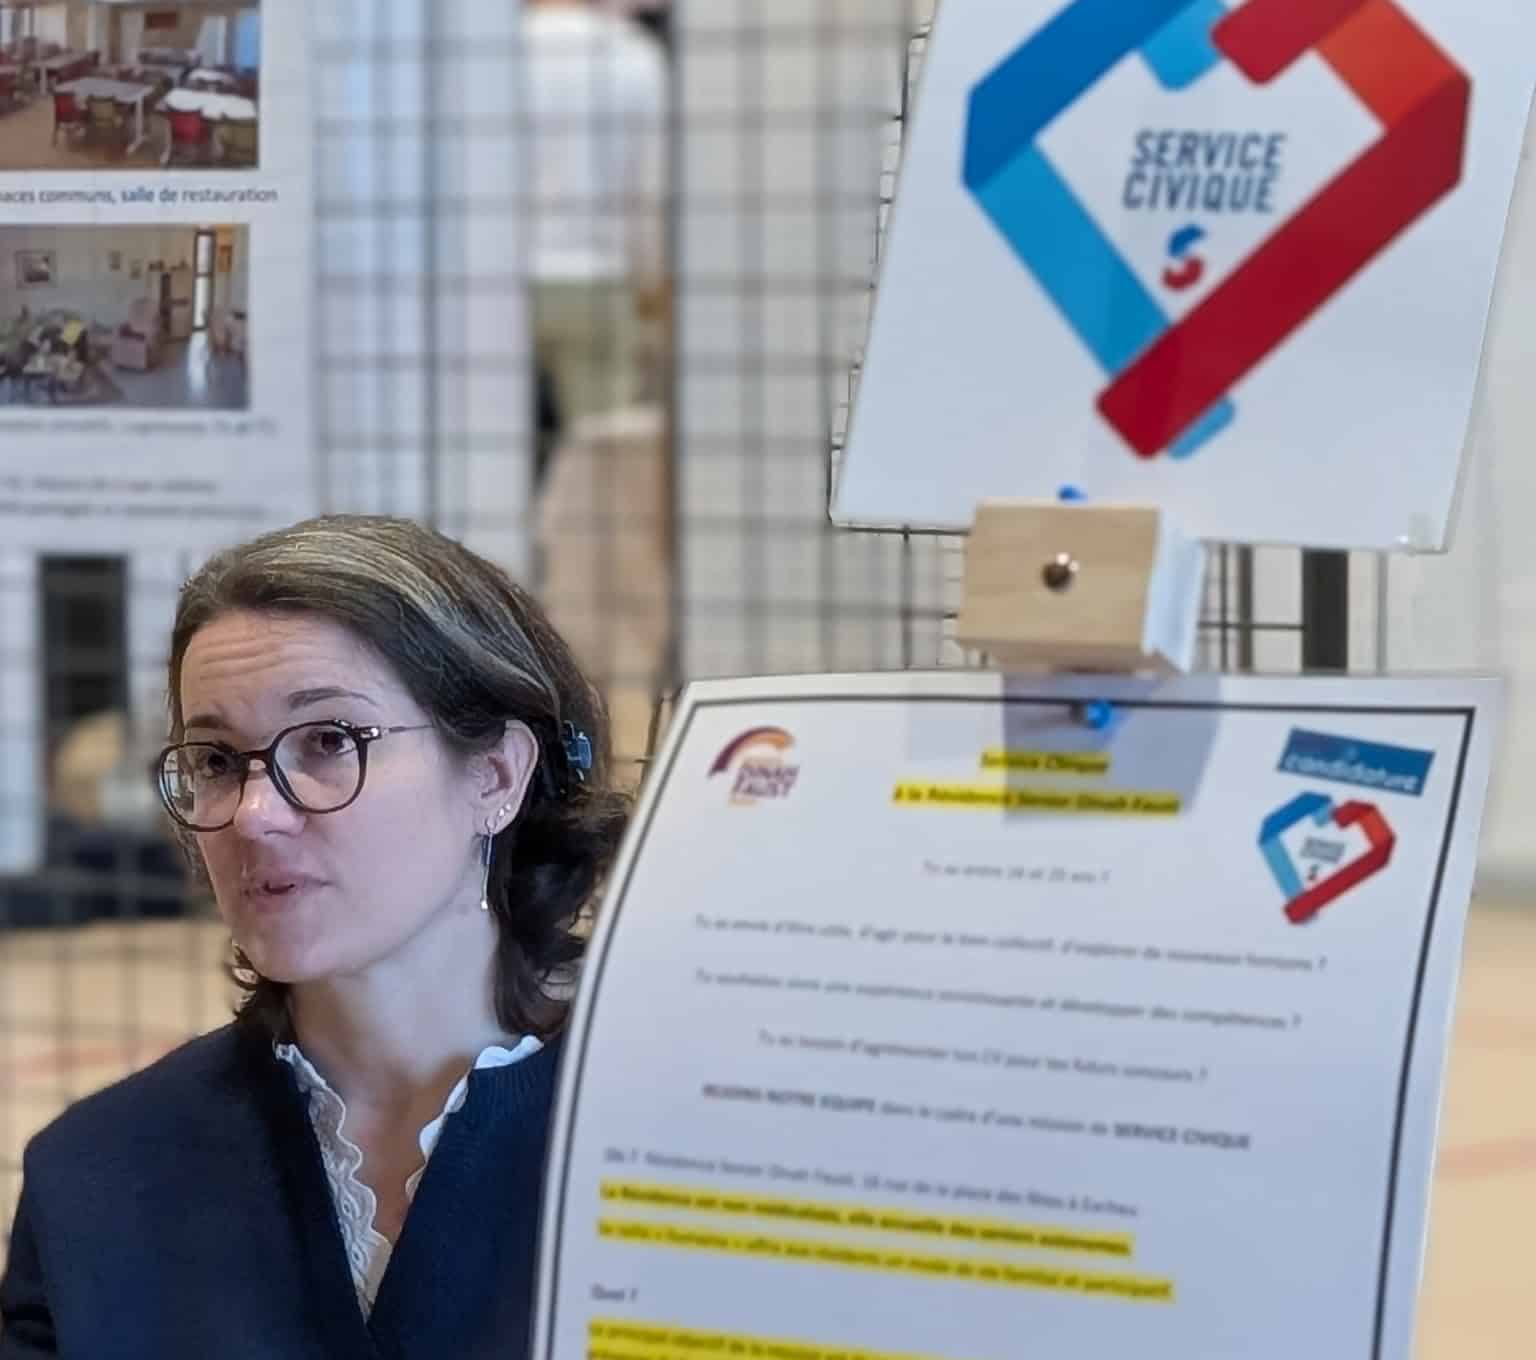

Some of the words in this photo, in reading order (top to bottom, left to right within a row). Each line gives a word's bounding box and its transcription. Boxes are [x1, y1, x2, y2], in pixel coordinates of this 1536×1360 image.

[1133, 129, 1288, 171] SERVICE
[121, 186, 155, 203] salle
[159, 187, 178, 203] de
[182, 185, 278, 203] restauration
[1122, 171, 1279, 213] CIVIQUE
